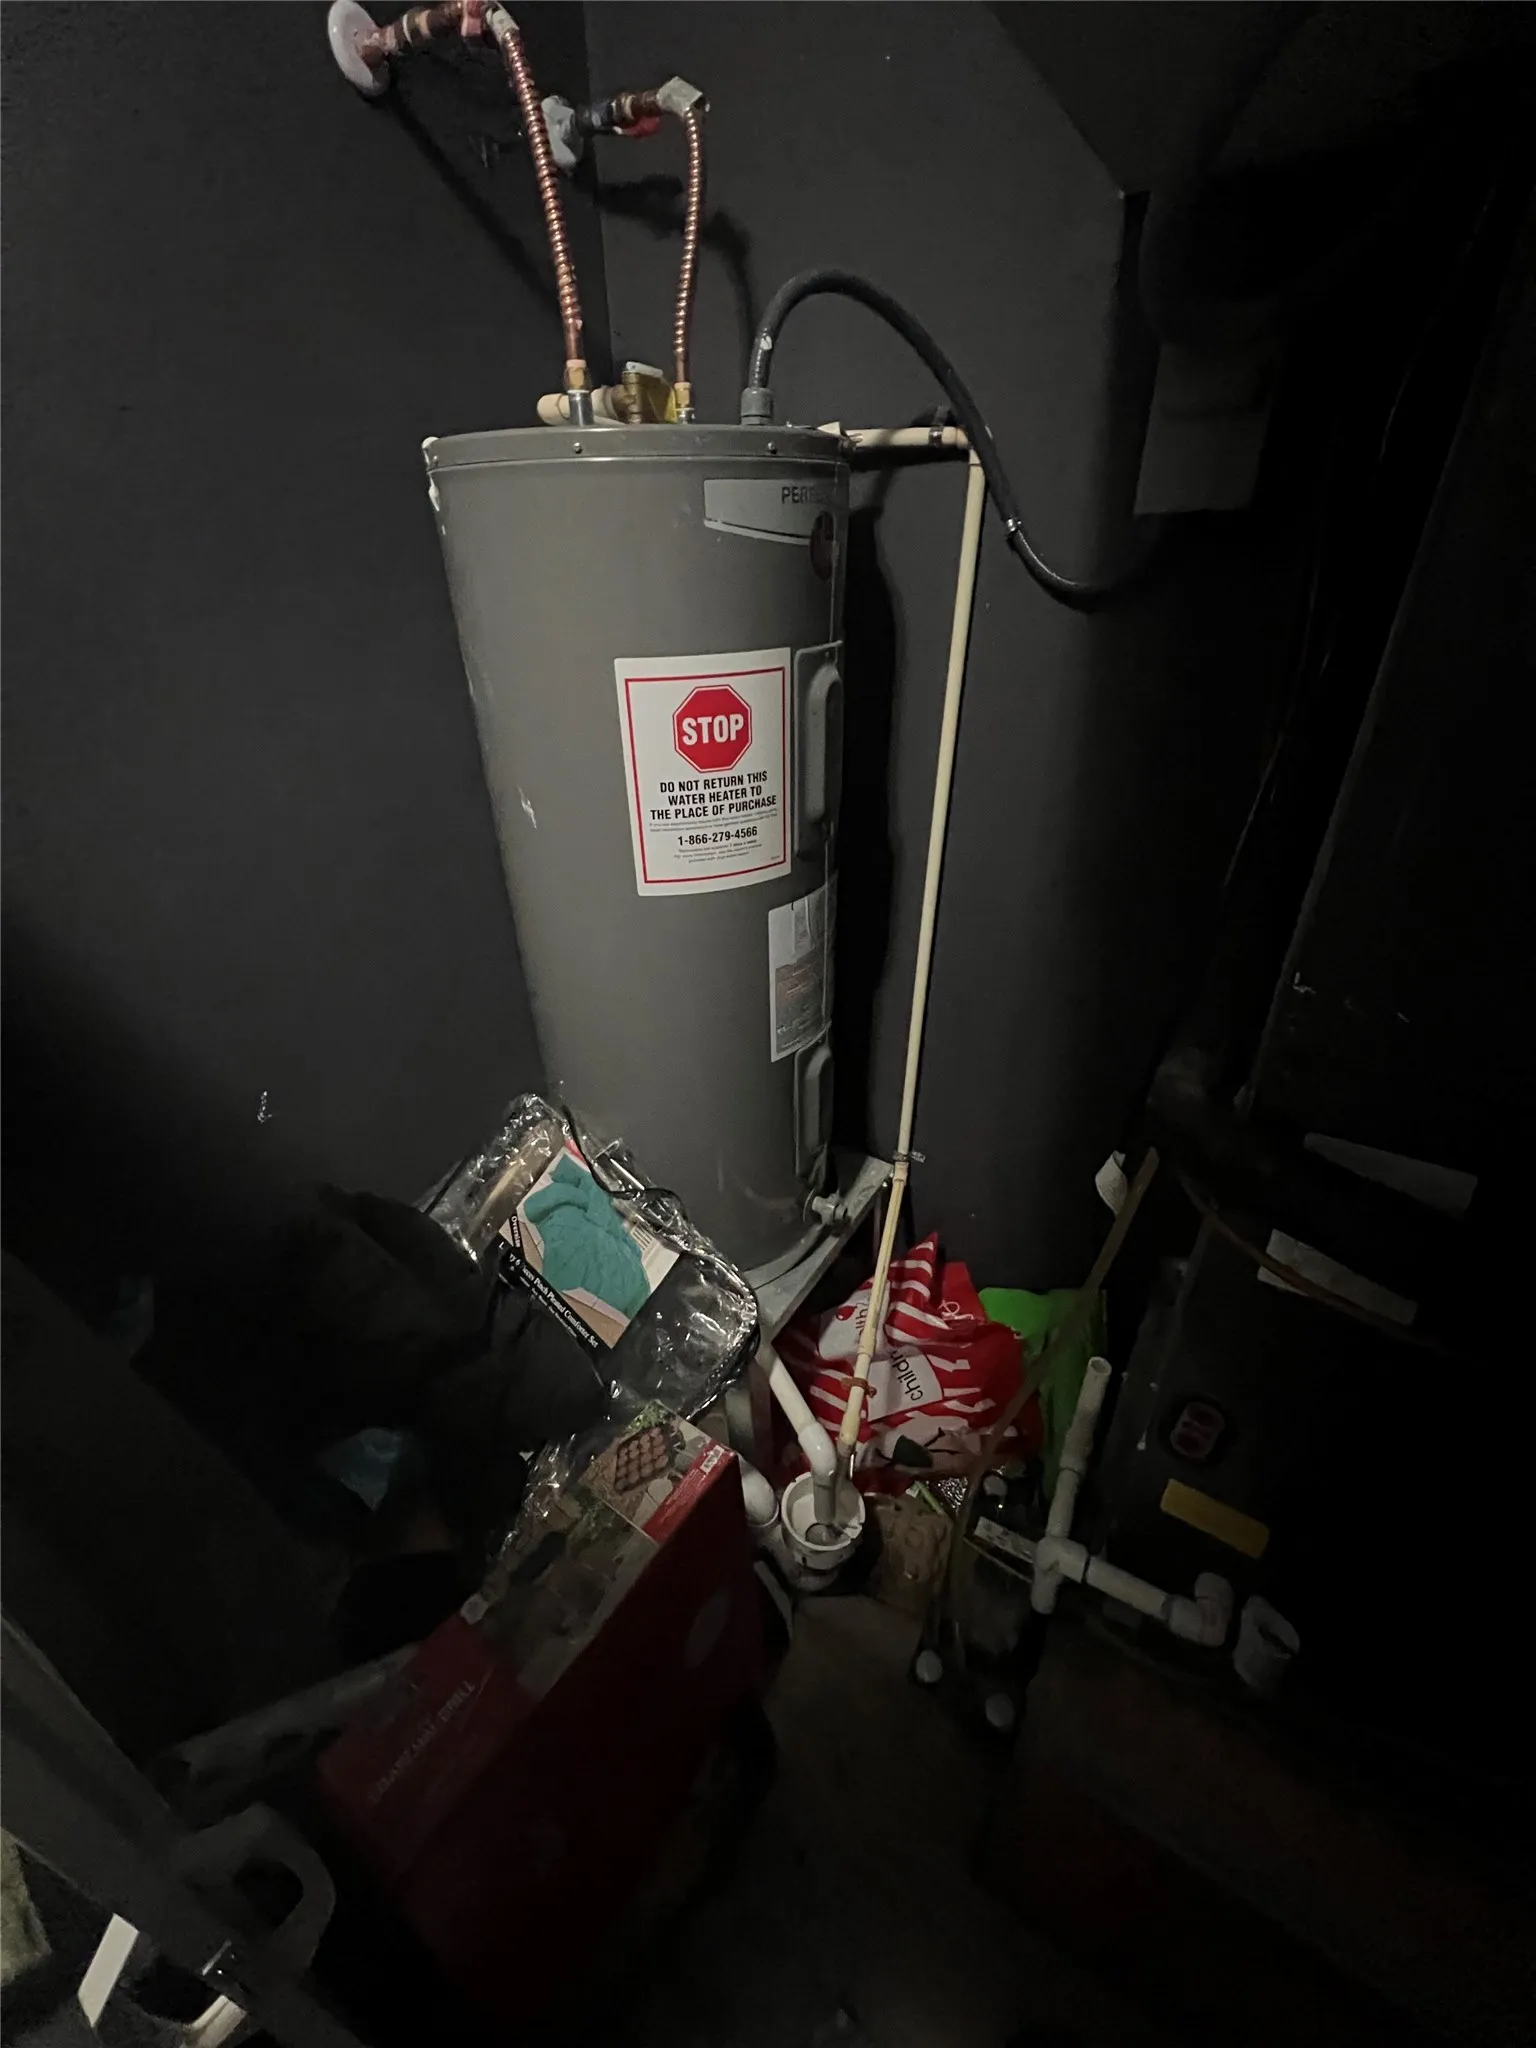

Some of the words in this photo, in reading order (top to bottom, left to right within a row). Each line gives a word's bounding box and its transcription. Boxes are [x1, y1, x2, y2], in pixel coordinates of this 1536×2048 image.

[682, 713, 745, 746] STOP
[660, 781, 675, 793] DO
[679, 779, 700, 792] NOT
[703, 774, 744, 790] RETURN
[747, 770, 768, 783] THIS
[650, 809, 671, 820] THE
[675, 805, 709, 819] PLACE
[712, 804, 725, 816] OF
[729, 795, 777, 813] PURCHASE
[668, 794, 706, 806] WATER
[709, 788, 748, 802] HEATER
[750, 785, 762, 797] TO
[677, 826, 758, 846] 1-866-279-4566
[562, 1308, 591, 1339] Comforter
[588, 1335, 599, 1348] Set
